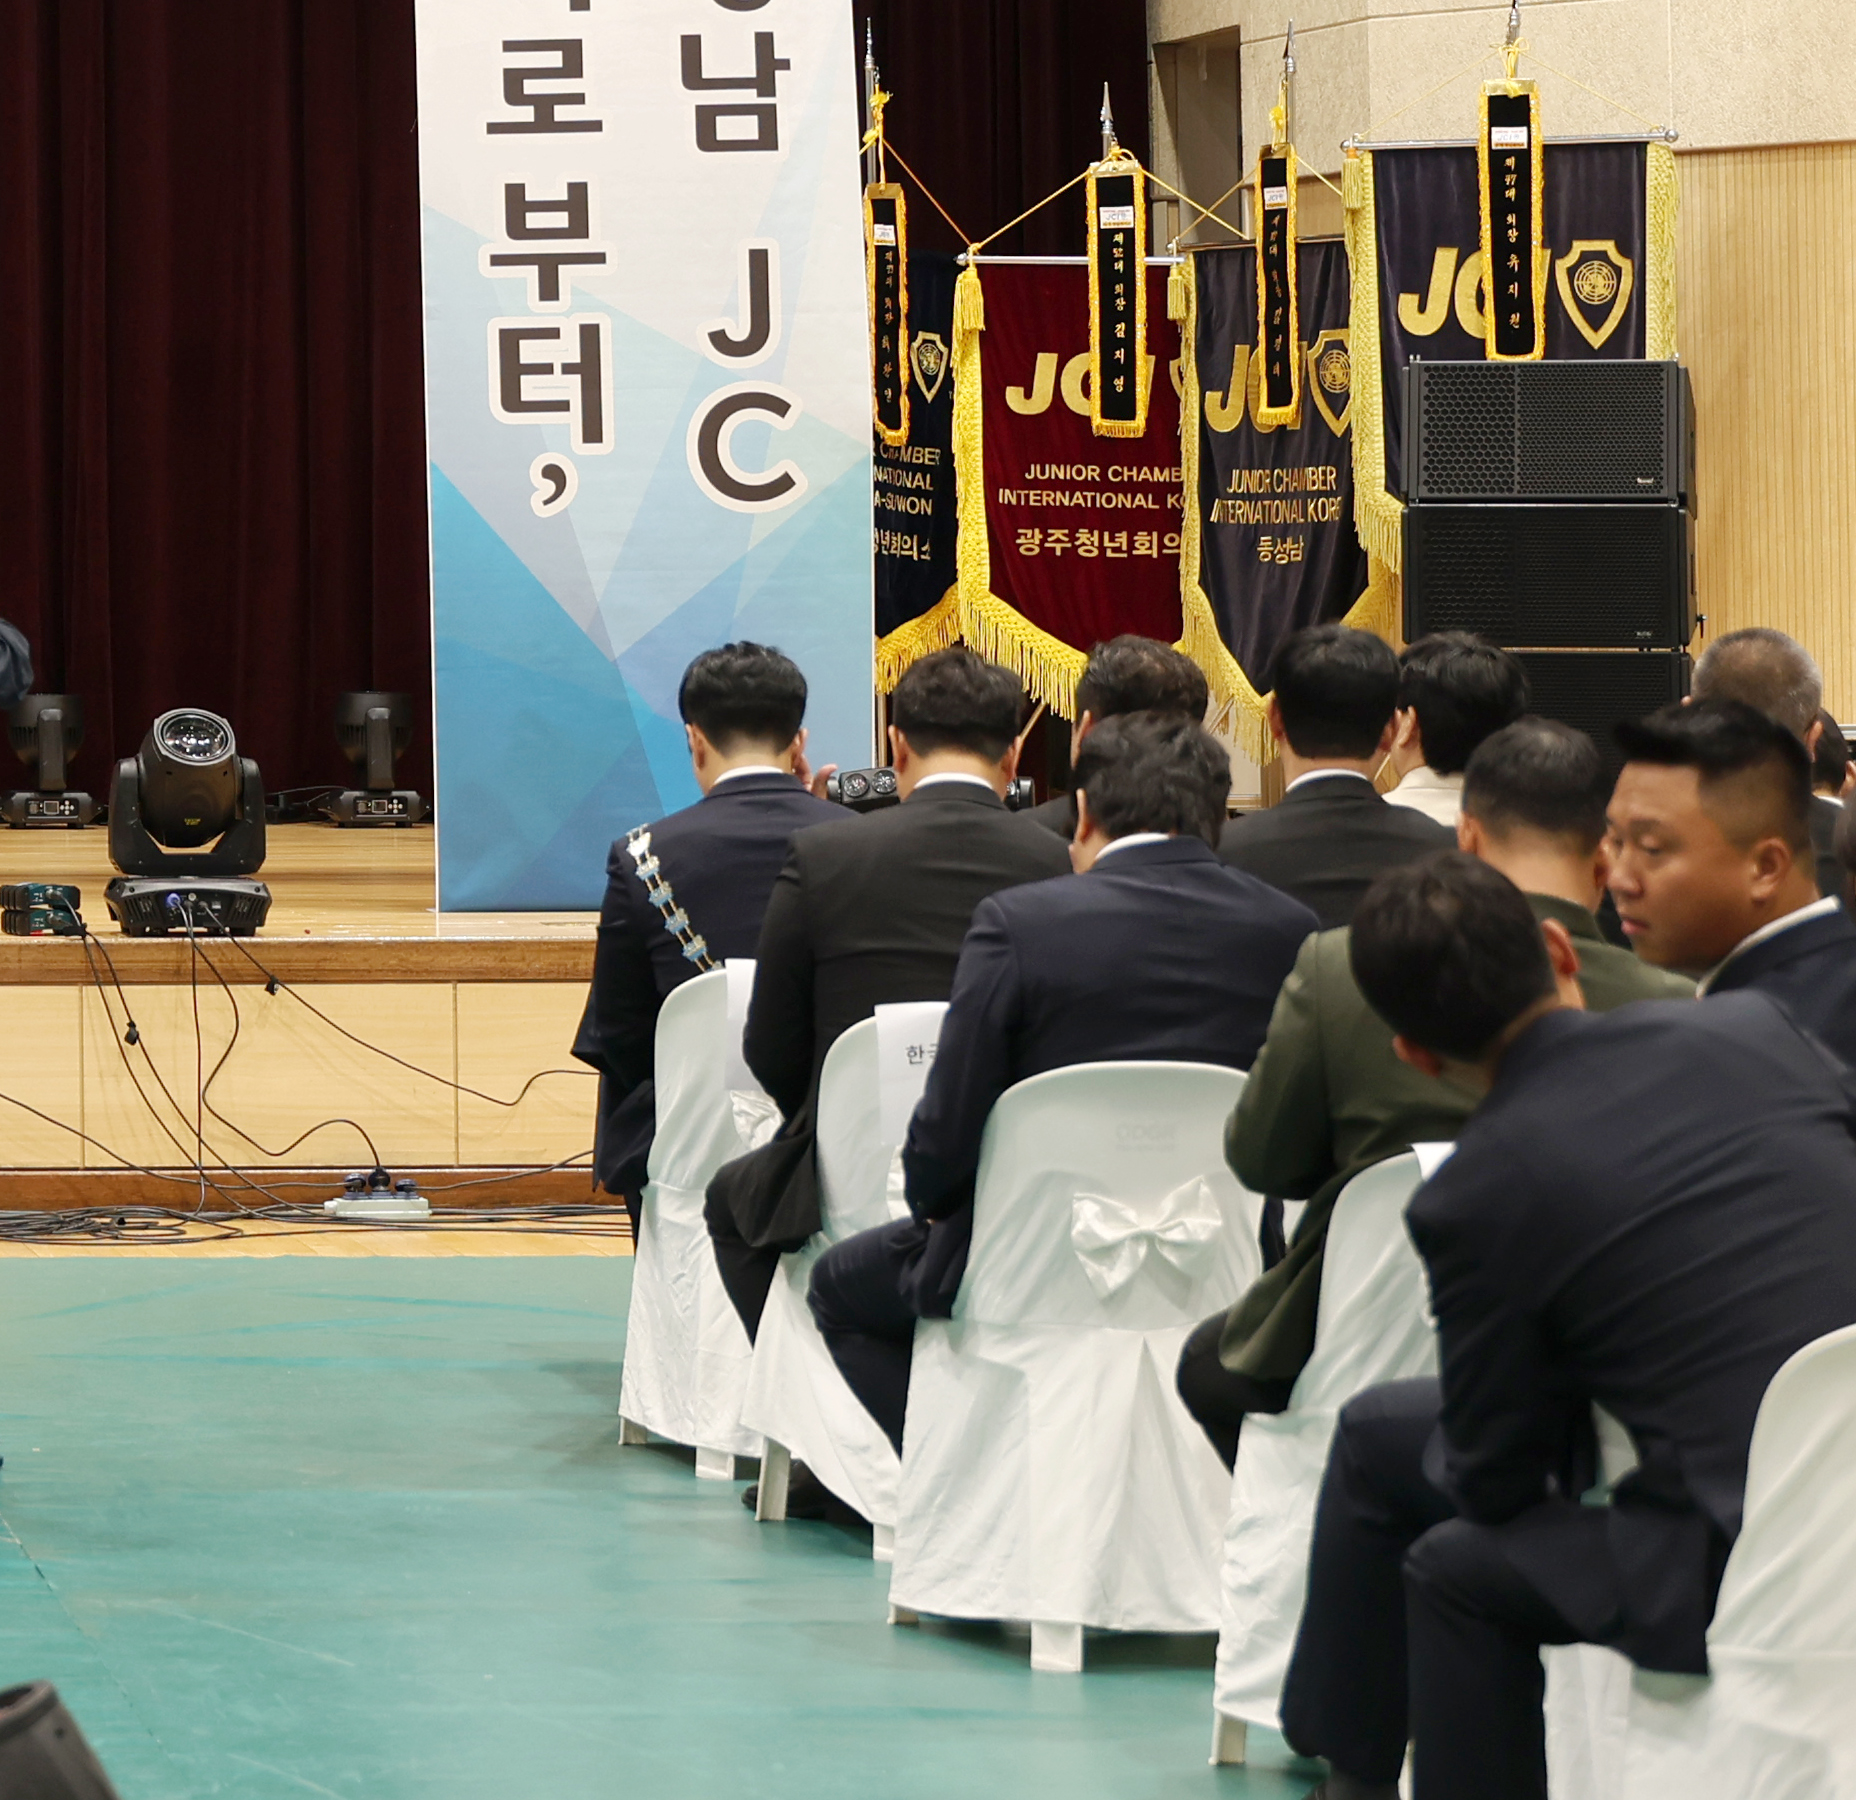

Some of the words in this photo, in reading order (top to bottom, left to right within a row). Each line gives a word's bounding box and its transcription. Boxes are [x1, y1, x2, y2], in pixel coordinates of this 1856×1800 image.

[696, 247, 798, 504] JC
[1024, 463, 1101, 483] JUNIOR
[1226, 468, 1271, 494] JUNIOR
[1273, 465, 1337, 493] CHAMBER
[998, 487, 1160, 510] INTERNATIONAL
[1209, 497, 1305, 525] INTERNATIONAL
[1256, 535, 1305, 565] 동성남
